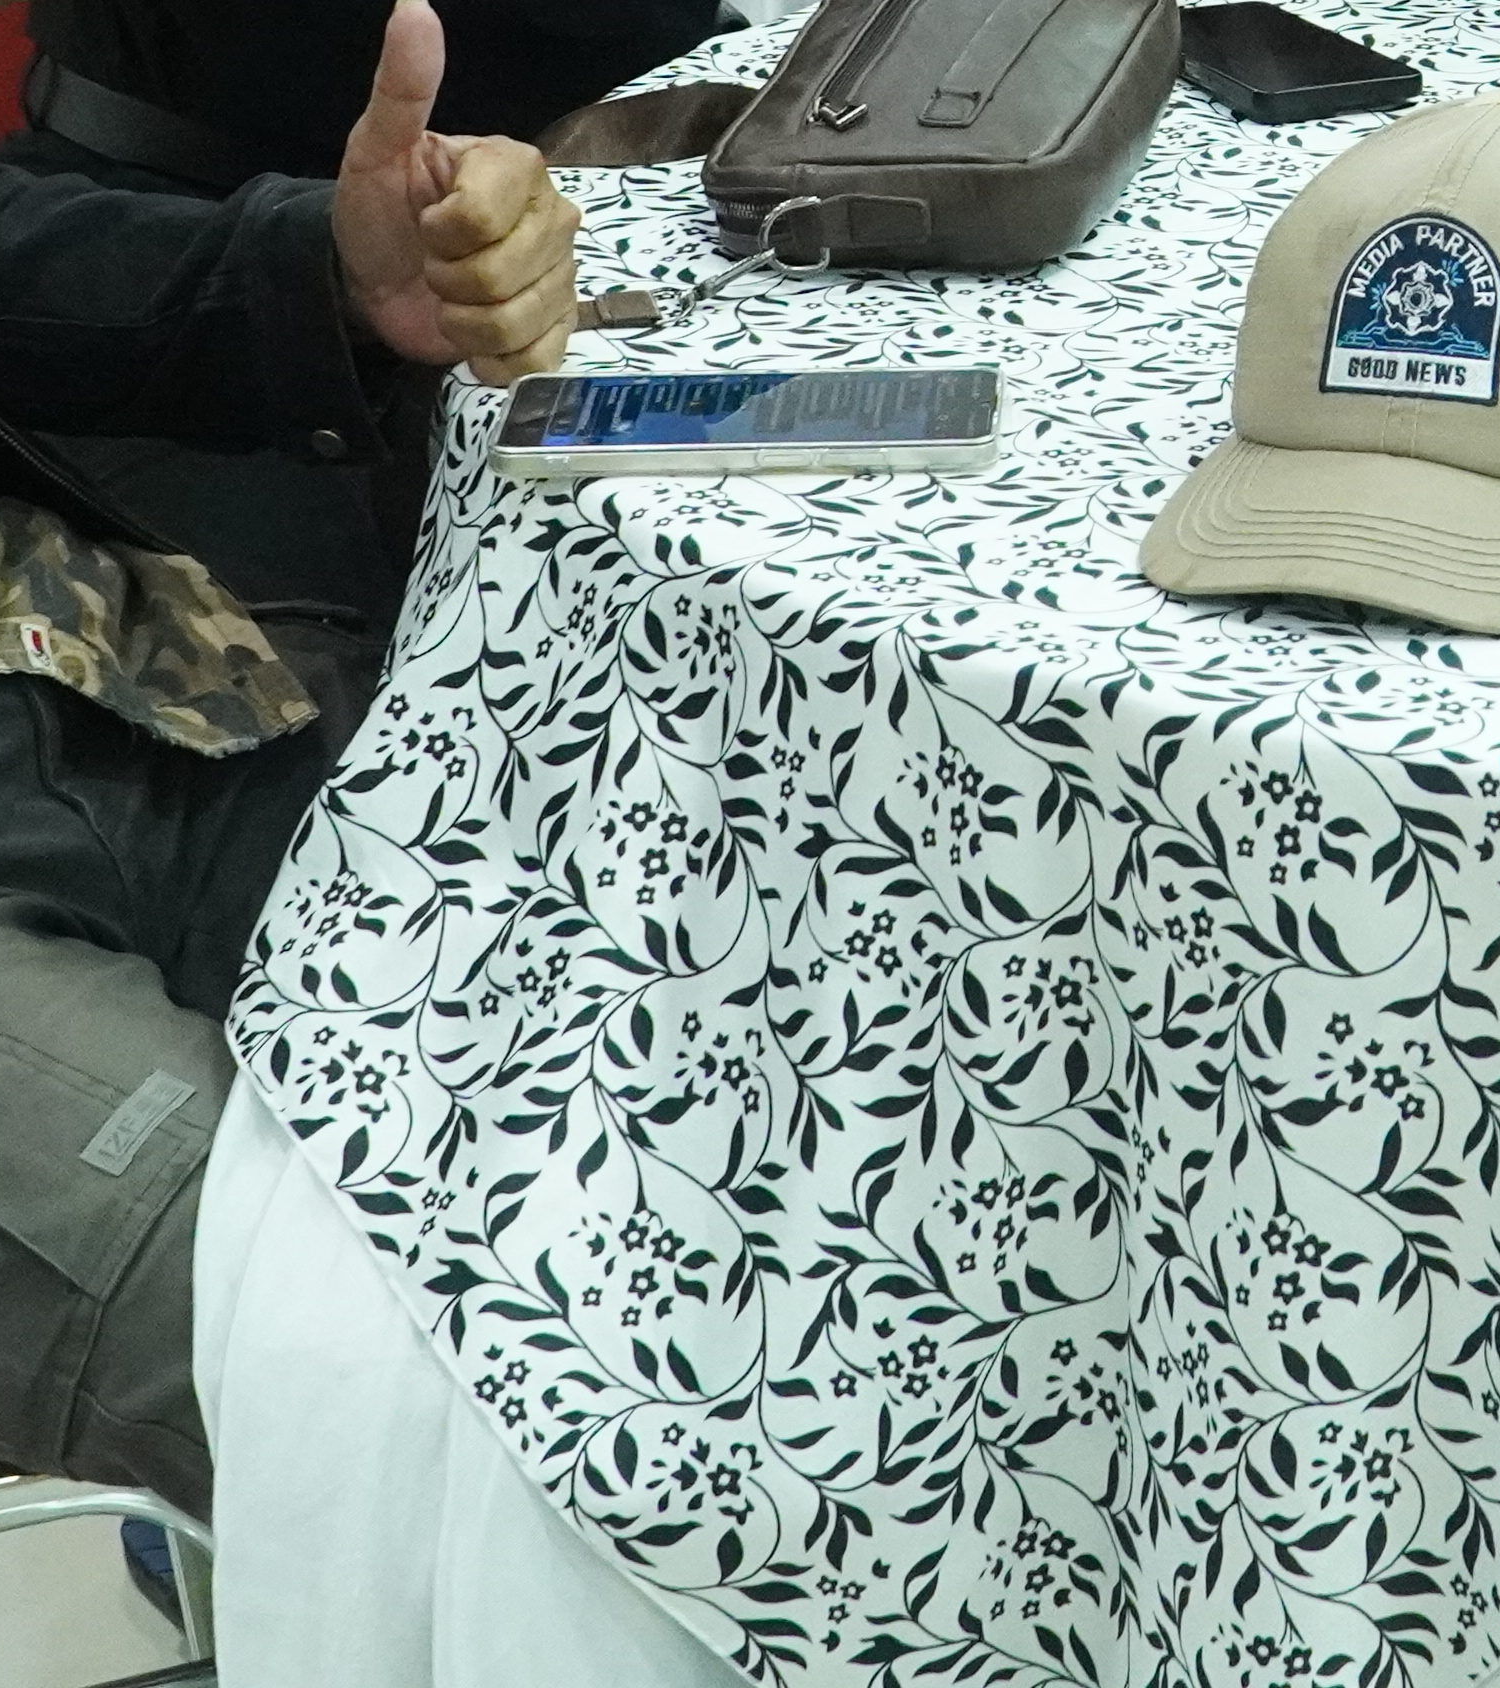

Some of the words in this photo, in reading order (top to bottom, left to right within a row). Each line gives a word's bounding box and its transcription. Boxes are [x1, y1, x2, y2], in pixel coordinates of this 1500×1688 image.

[1347, 233, 1405, 298] MEDIA
[1416, 225, 1496, 307] PARTNER
[1347, 356, 1399, 380] GOOD
[1405, 358, 1467, 387] NEWS
